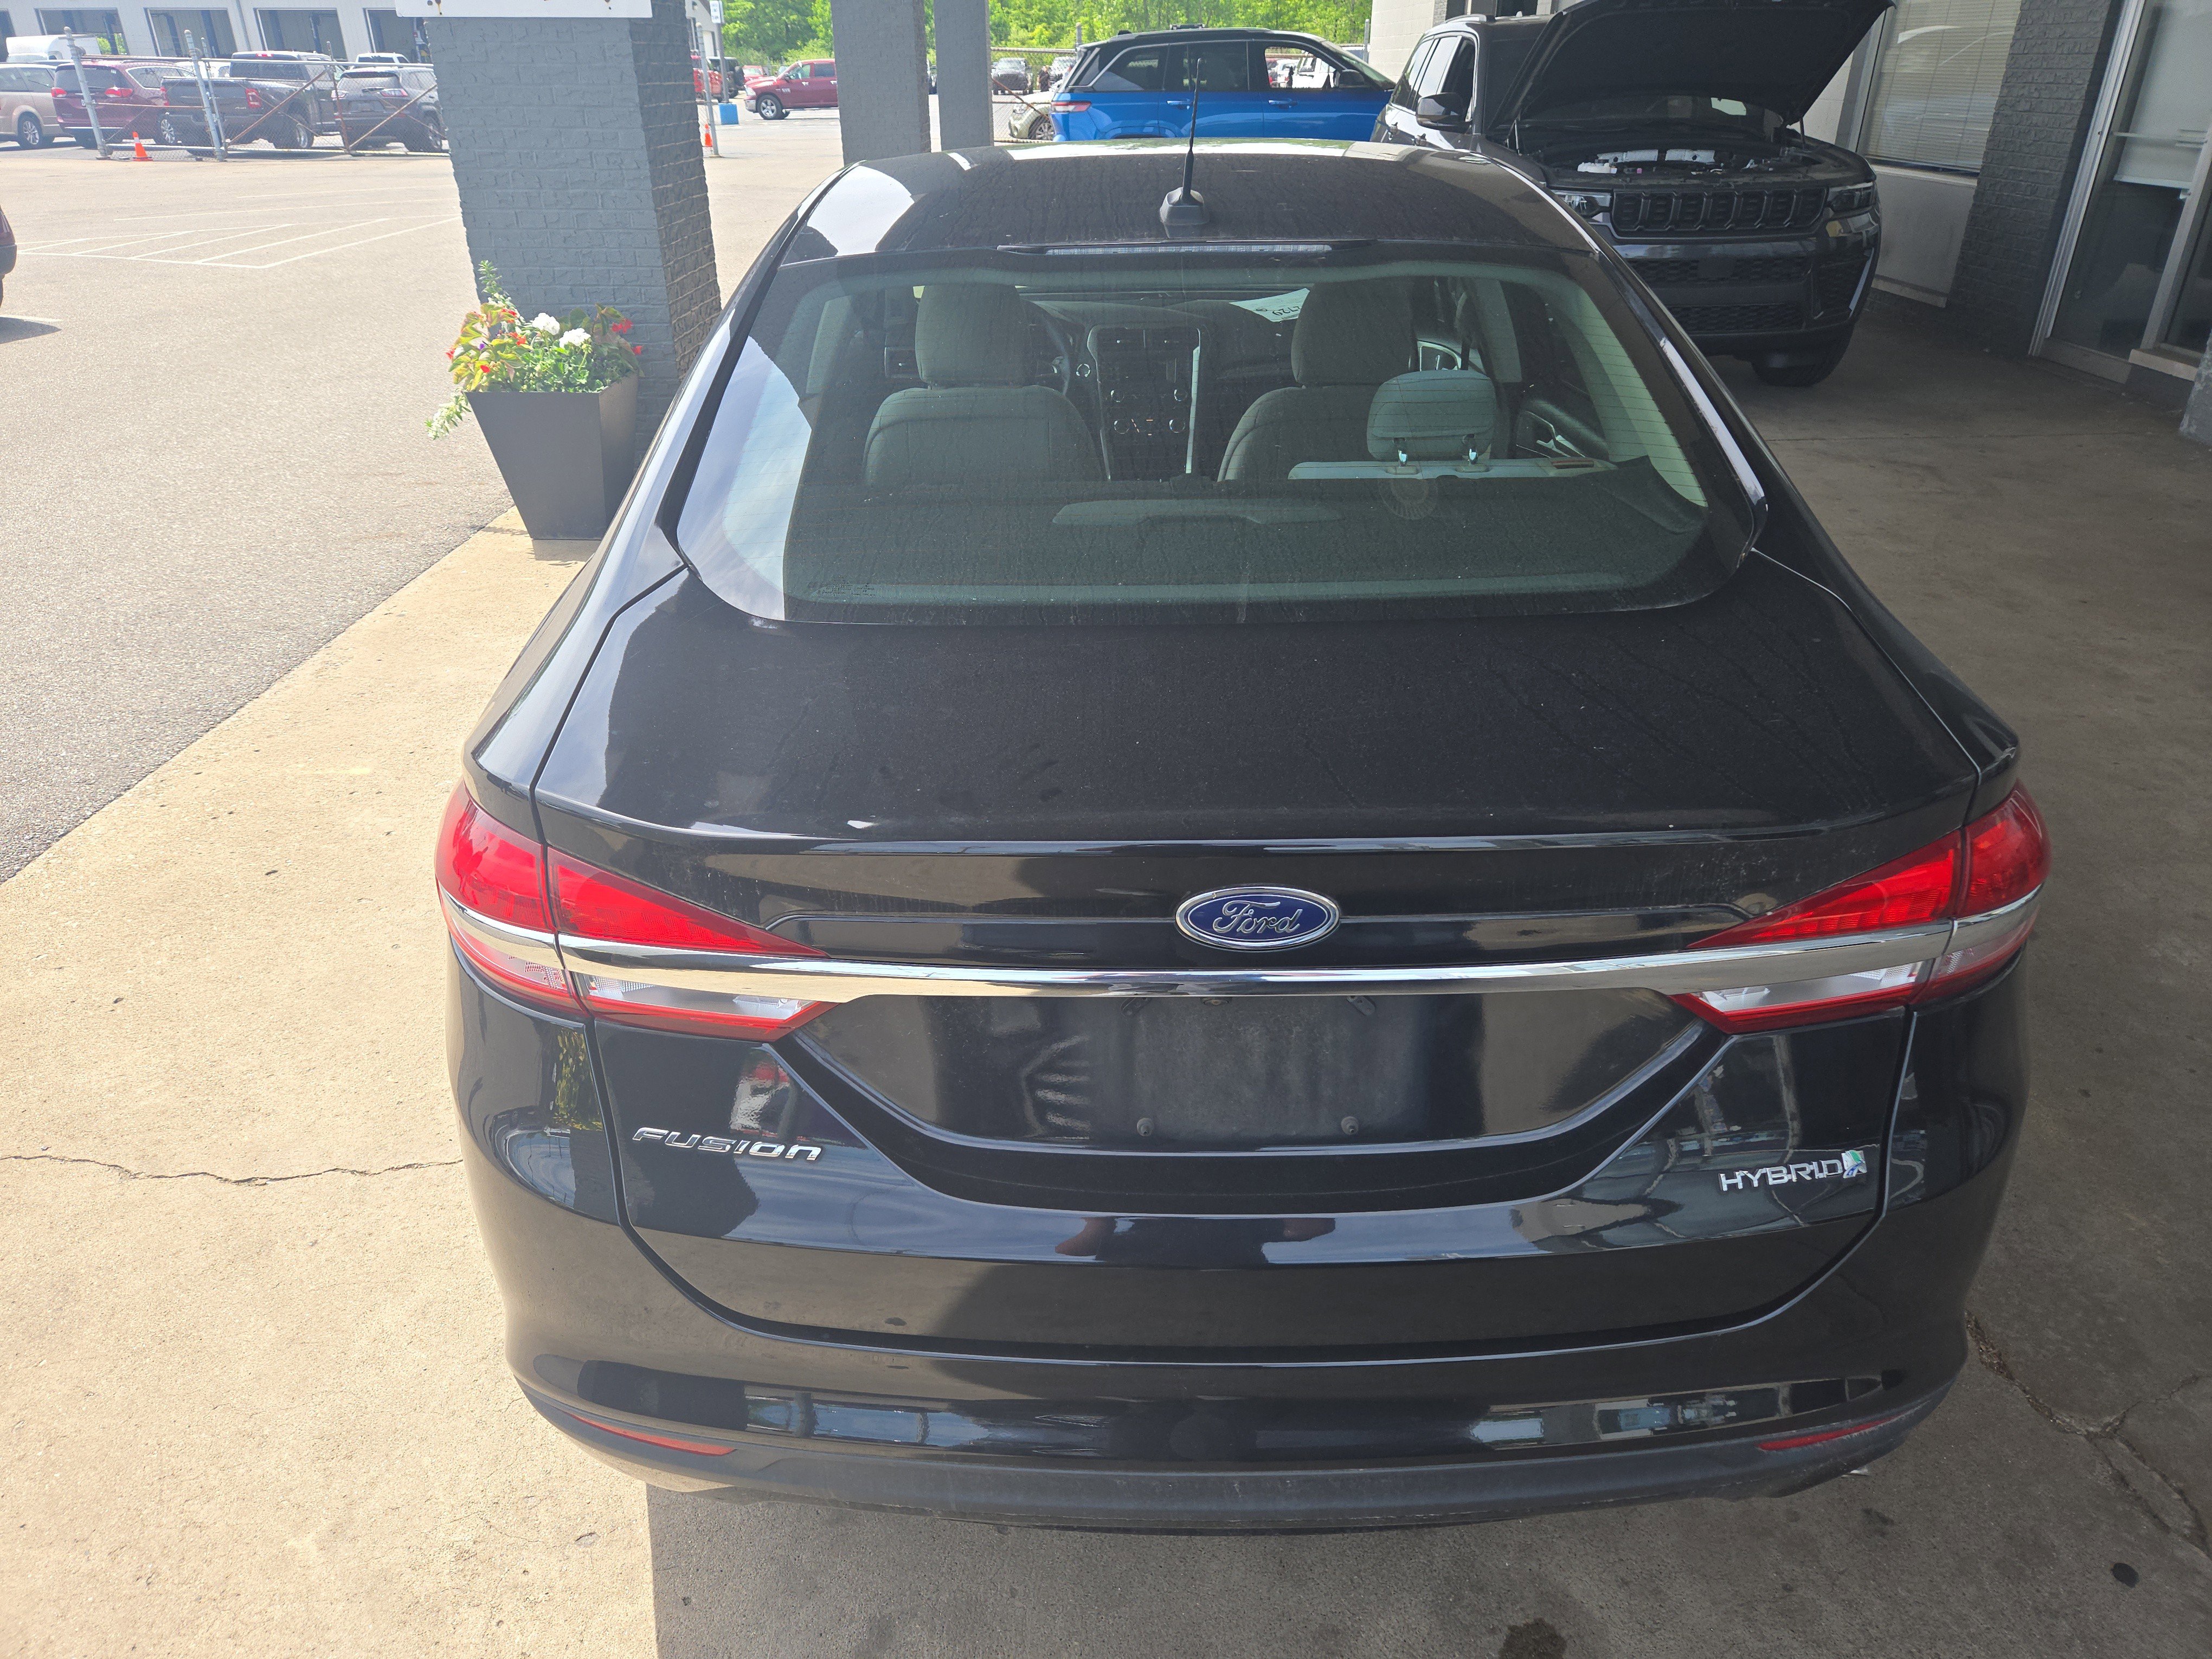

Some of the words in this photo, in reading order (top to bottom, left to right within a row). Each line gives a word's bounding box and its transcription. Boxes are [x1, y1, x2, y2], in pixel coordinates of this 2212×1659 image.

[1213, 900, 1303, 934] Ford
[632, 1127, 822, 1161] FUSION
[1718, 1159, 1843, 1191] HYBRID
